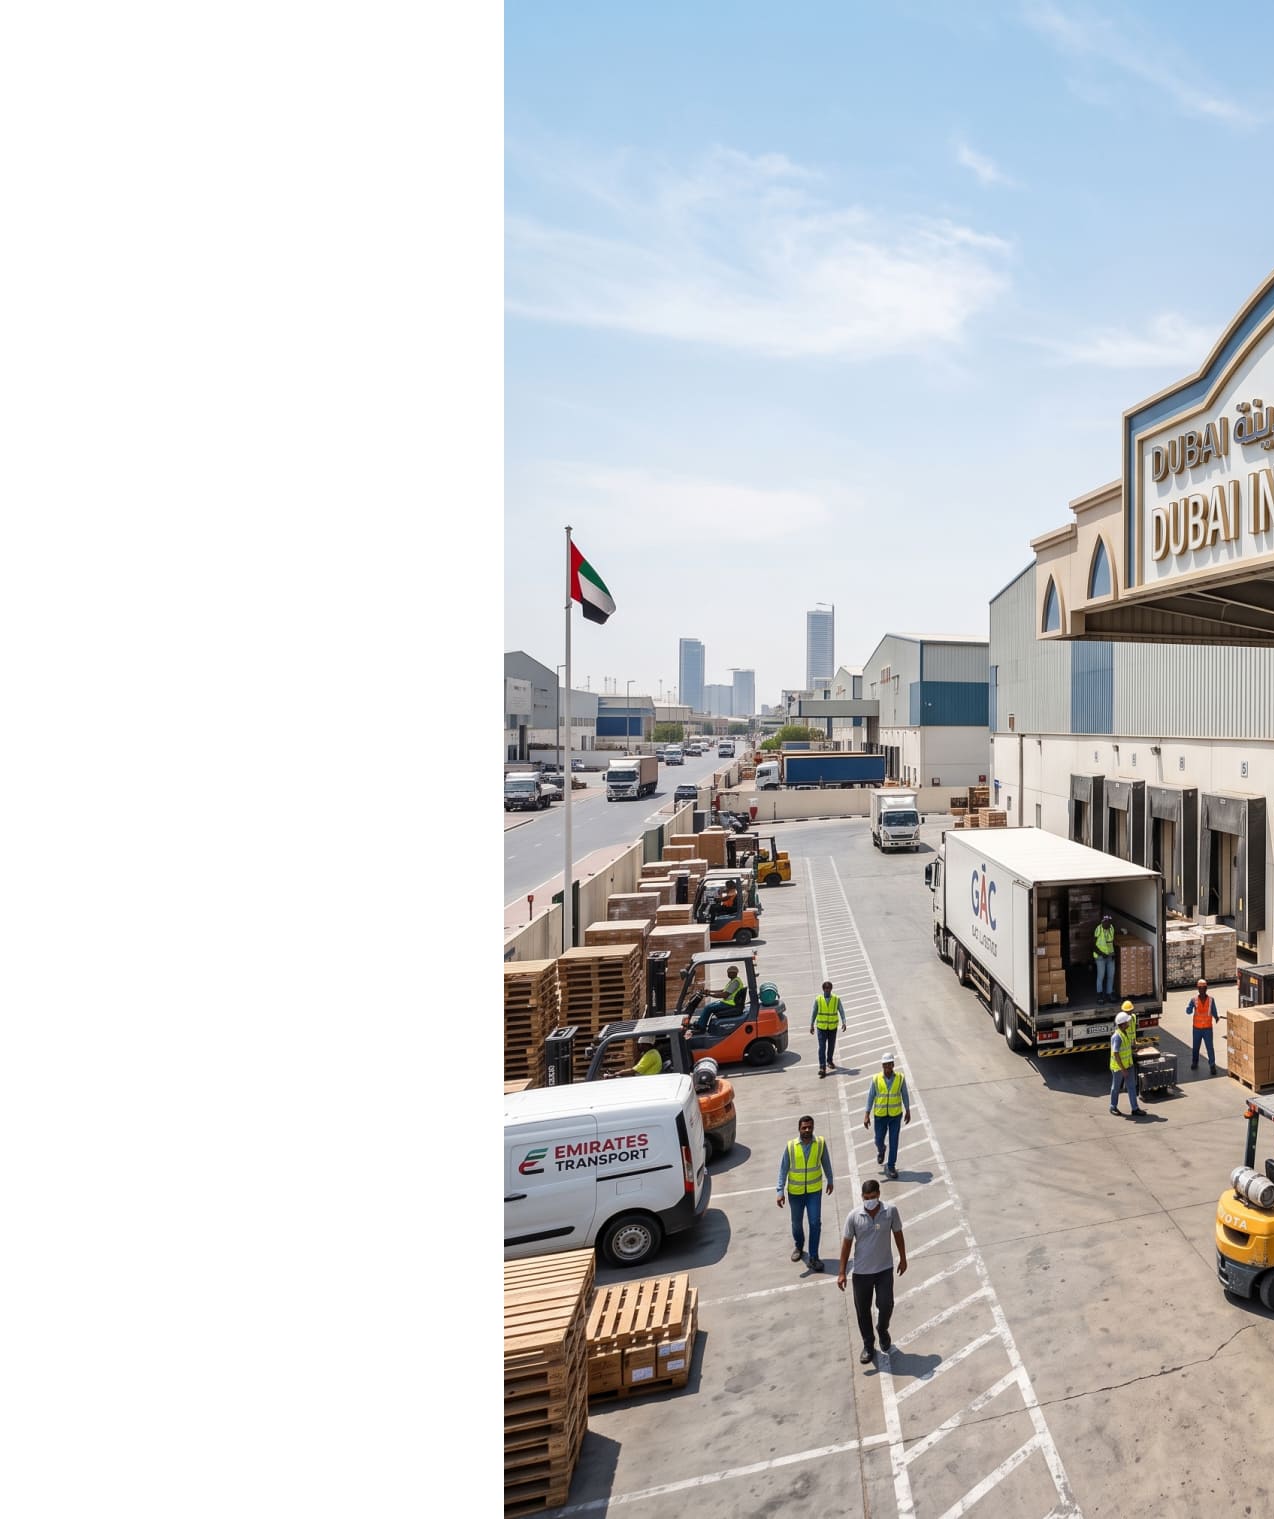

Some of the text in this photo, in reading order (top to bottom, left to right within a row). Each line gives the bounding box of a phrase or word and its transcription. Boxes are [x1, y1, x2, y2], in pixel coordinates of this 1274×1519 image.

[1151, 416, 1229, 482] DUBAI
[1151, 479, 1240, 561] DUBAI
[971, 870, 996, 931] GAC
[555, 1133, 649, 1159] EMIRATES
[555, 1148, 649, 1171] TRANSPORT
